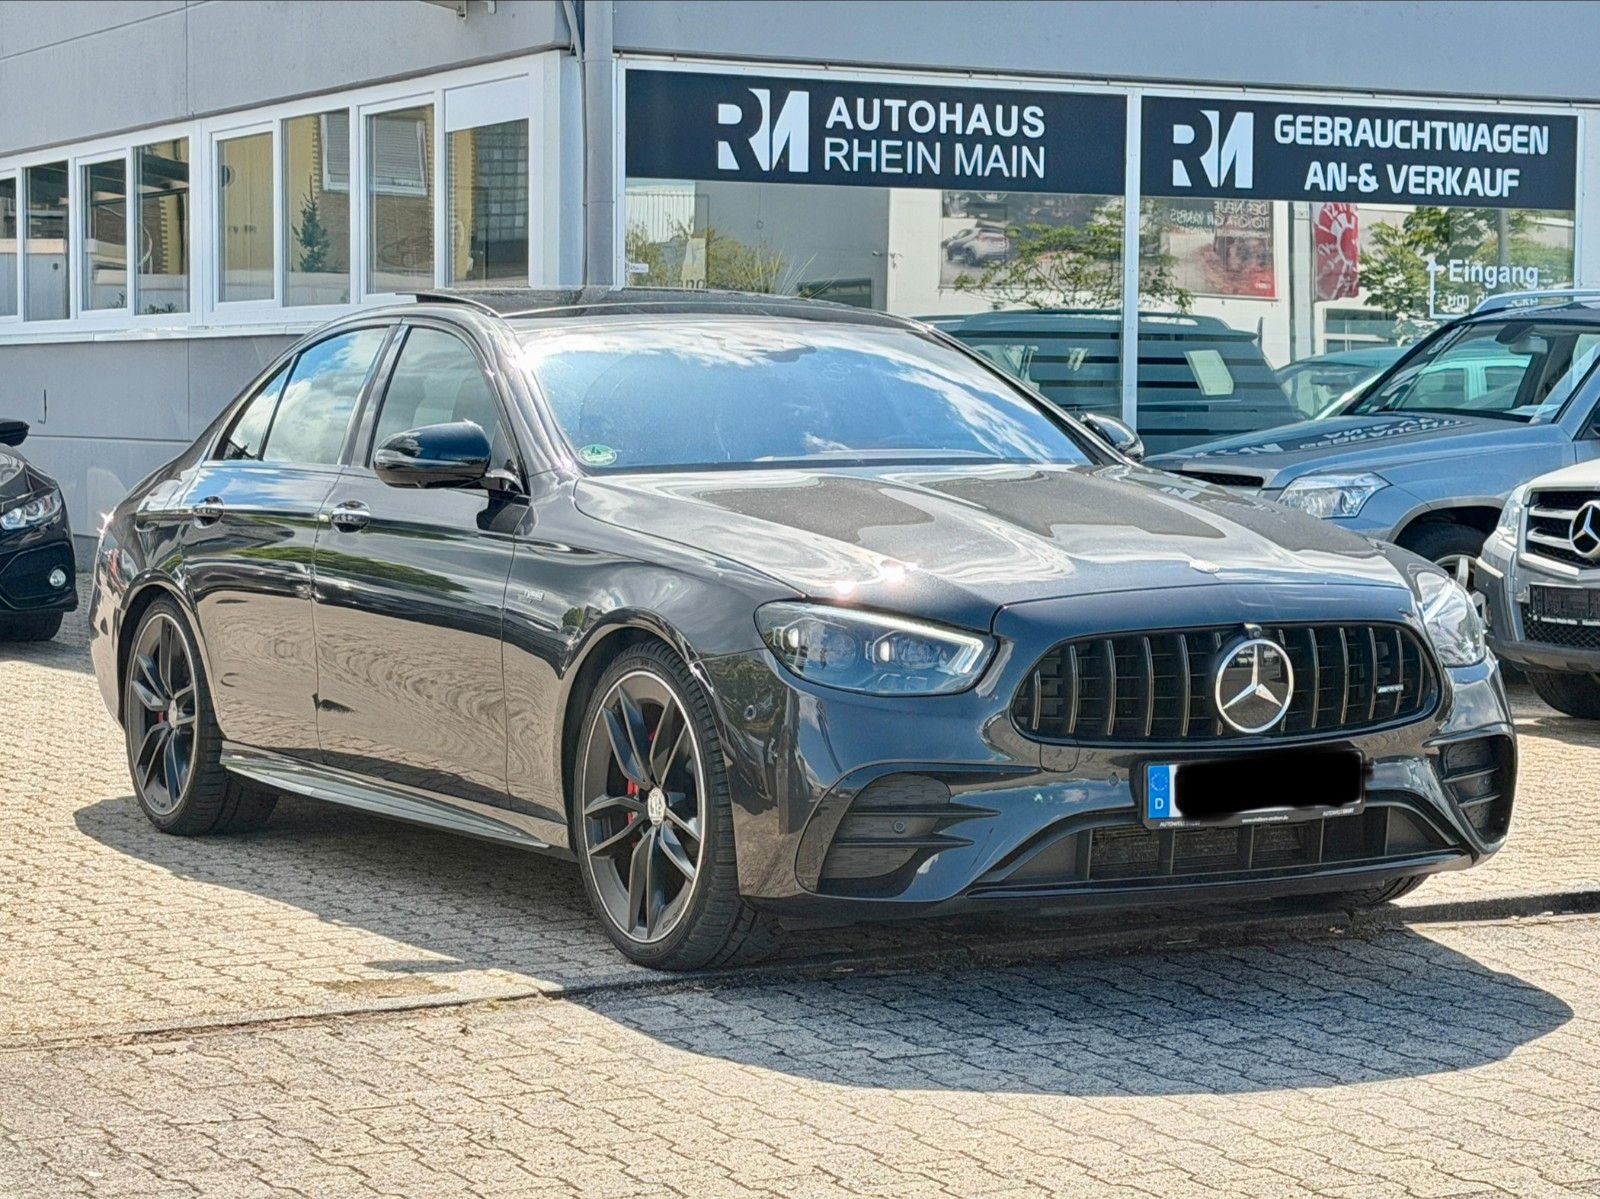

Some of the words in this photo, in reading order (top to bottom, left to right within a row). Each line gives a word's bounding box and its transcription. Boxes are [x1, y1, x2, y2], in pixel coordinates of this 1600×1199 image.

[716, 87, 810, 173] RM
[825, 96, 1045, 138] AUTOHAUS
[1274, 114, 1549, 155] GEBRAUCHTWAGEN
[824, 136, 941, 175] RHEIN
[954, 142, 1045, 179] MAIN
[1172, 109, 1254, 189] RM
[1303, 160, 1380, 193] AN-&
[1386, 163, 1520, 198] VERKAUF
[1449, 259, 1539, 289] Eingang
[1154, 797, 1164, 810] D
